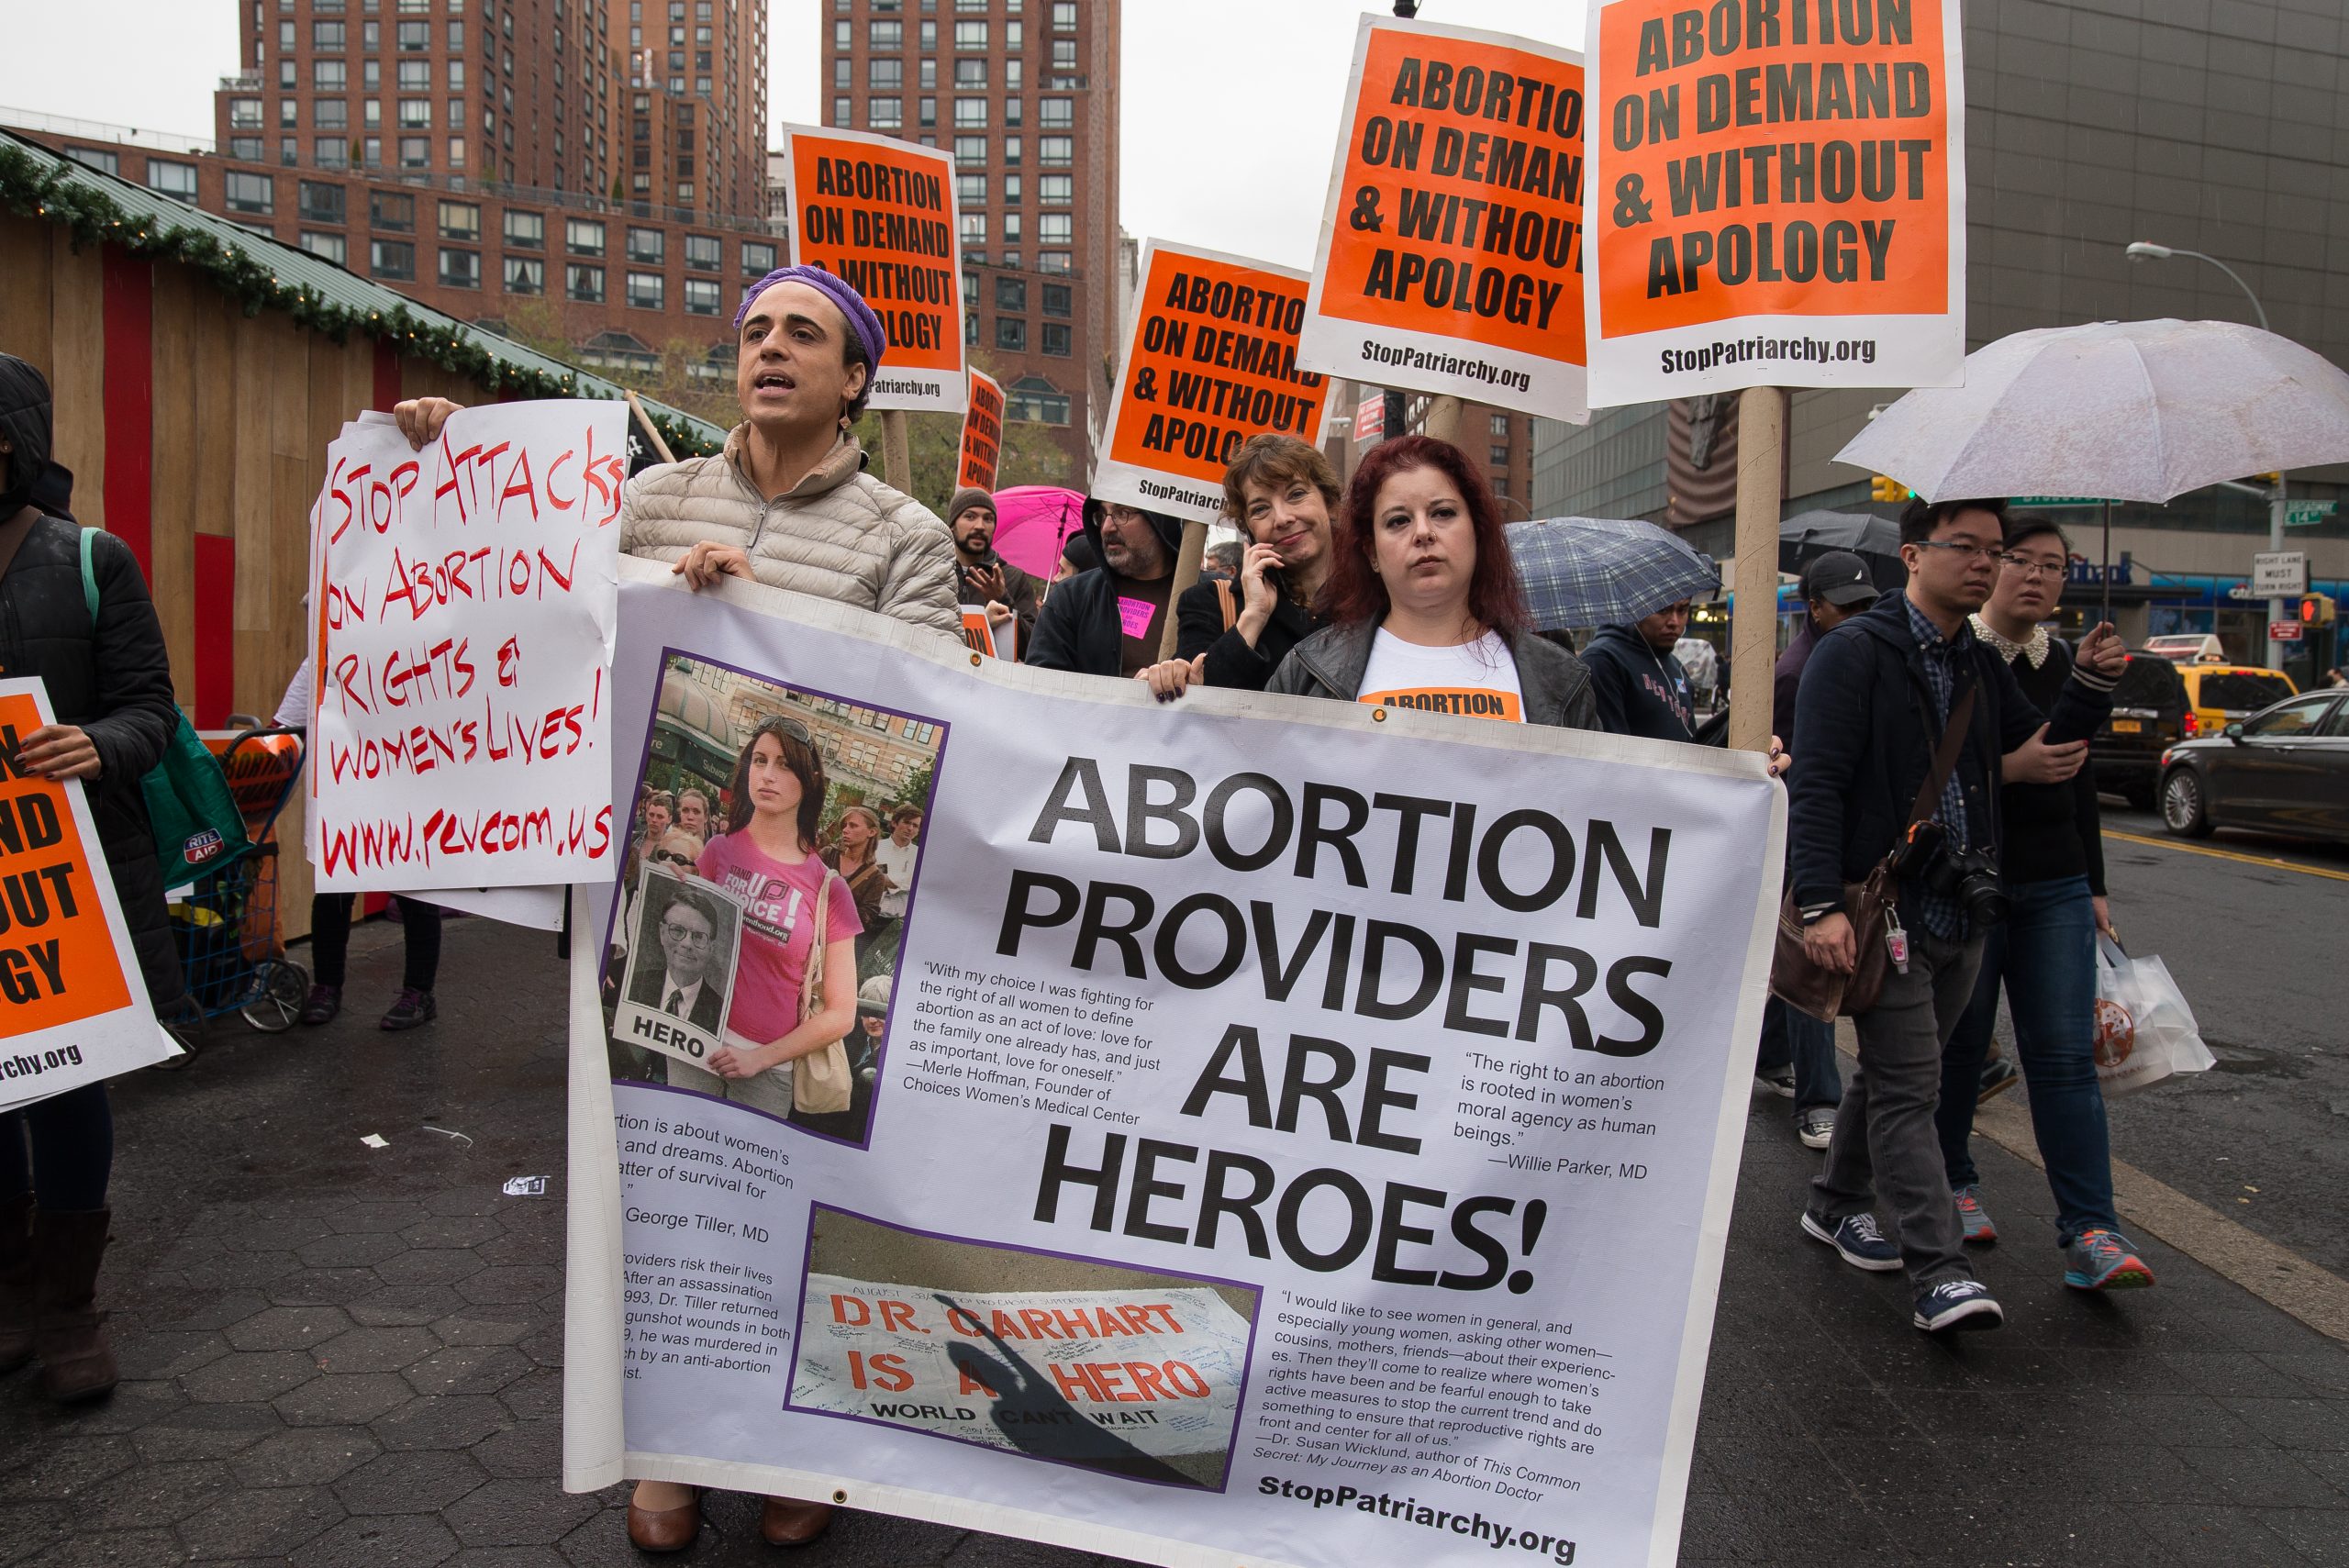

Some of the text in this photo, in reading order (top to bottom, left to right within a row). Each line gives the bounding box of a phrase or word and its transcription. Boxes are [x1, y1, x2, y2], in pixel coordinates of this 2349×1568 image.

[1390, 57, 1584, 142] ABORTIO
[1612, 61, 1932, 152] ON DEMAND
[817, 156, 942, 212] ABORTION
[1361, 115, 1584, 207] ON DEMAN
[1612, 139, 1932, 228] & WITHOUT
[806, 204, 950, 259] ON DEMAND
[1349, 184, 1385, 234] &
[839, 258, 951, 306] WITHOUT
[1647, 218, 1897, 300] APOLOGY
[1165, 272, 1307, 336] ABORTIO
[1364, 248, 1564, 330] APOLOGY
[874, 308, 941, 351] LOGY
[1142, 316, 1189, 358] ON
[1361, 339, 1531, 393] StopPatriarchy.org
[1661, 335, 1876, 375] StopPatriarchy.org
[1133, 367, 1158, 402] &
[1167, 369, 1316, 436] WITHOUT
[1141, 413, 1248, 467] APOLO
[329, 457, 419, 545] STOP
[2295, 512, 2309, 523] 14
[328, 538, 581, 630] ON ABORTION
[2265, 569, 2292, 579] MUST
[336, 637, 476, 719] RIGHTS
[331, 667, 602, 785] WOMEN'S LIVES!
[1383, 694, 1505, 716] ABORTION
[702, 758, 729, 782] Subway
[189, 831, 217, 848] RITE
[195, 845, 218, 862] AID
[1027, 755, 1673, 929] ABORTION
[729, 865, 752, 880] STAND
[924, 961, 1154, 1011] “With my choice I was fighting for
[996, 868, 1673, 1059] PROVIDERS
[920, 980, 1133, 1028] the right of all women to define
[632, 1015, 705, 1060] HERO
[906, 1059, 1112, 1101] —Merle Hoffman, Founder of
[1180, 1022, 1432, 1156] ARE
[1461, 1074, 1632, 1111] is rooted in women’s
[1465, 1051, 1664, 1091] “The right to an abortion
[903, 1076, 1141, 1125] Choices Women’s Medical Center
[1457, 1102, 1656, 1135] moral agency as human
[1453, 1121, 1524, 1147] beings.”
[1487, 1153, 1647, 1179] —Willie Parker, MD
[626, 1207, 769, 1243] George Tiller, MD
[1032, 1123, 1548, 1295] HEROES!
[853, 1286, 900, 1297] AUGUST
[1282, 1289, 1573, 1335] “I would like to see women in general, and
[625, 1311, 790, 1340] gunshot wounds in both
[829, 1294, 931, 1336] DR.
[946, 1304, 1185, 1340] CARHART
[847, 1351, 915, 1392] IS
[958, 1360, 998, 1397] A
[1049, 1360, 1211, 1403] HERO
[871, 1403, 976, 1421] WORLD
[1088, 1410, 1161, 1425] WAIT
[1253, 1447, 1544, 1502] Secret: My Journey as an Abortion Doctor
[1255, 1433, 1581, 1492] —Dr. Susan Wicklund, author of This Common
[1257, 1475, 1576, 1566] StopPatriarchy.org
